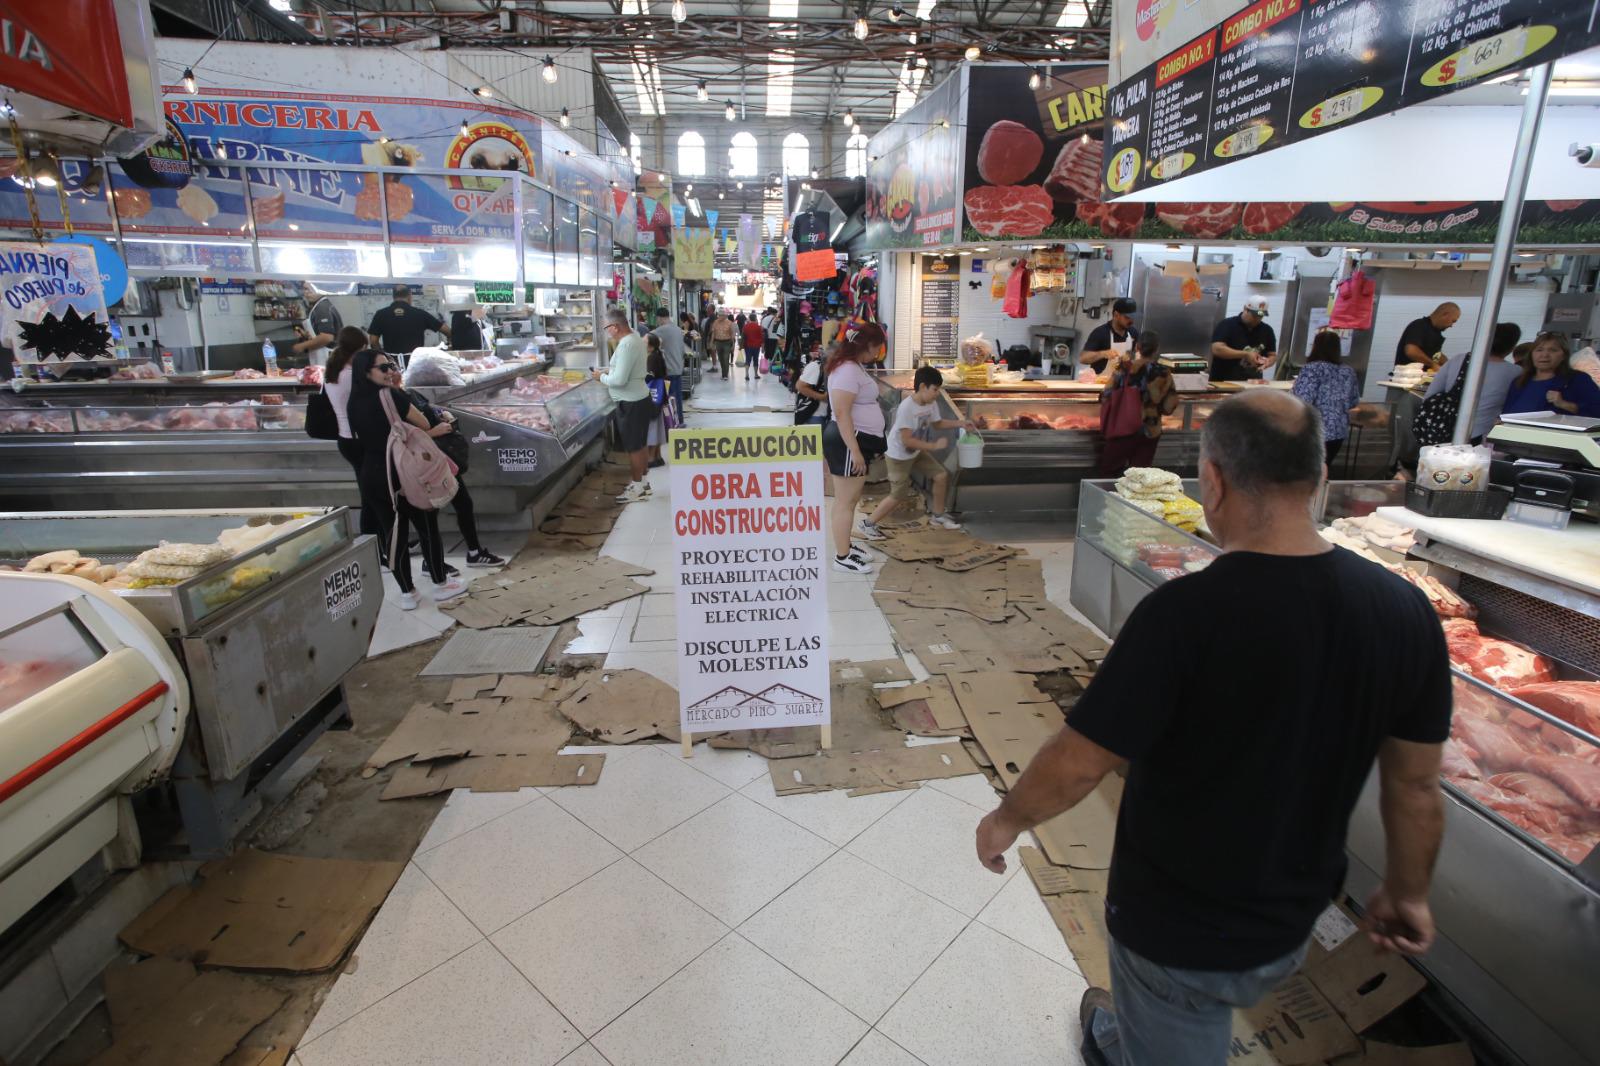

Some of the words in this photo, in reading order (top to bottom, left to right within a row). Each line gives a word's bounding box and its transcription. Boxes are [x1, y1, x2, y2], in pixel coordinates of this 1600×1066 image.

[1225, 8, 1263, 44] COMBO
[1265, 0, 1285, 22] NO.
[1422, 39, 1434, 54] 1/2
[1434, 34, 1449, 50] Kg.
[1451, 28, 1462, 43] de
[1464, 12, 1500, 38] Chilorio
[1425, 22, 1437, 37] 1/2
[1438, 17, 1452, 33] Kg.
[1454, 10, 1466, 23] de
[1159, 53, 1188, 81] COMBO
[1189, 44, 1204, 66] NO.
[1207, 39, 1212, 55] 1
[1110, 96, 1115, 116] 1
[1115, 93, 1125, 117] Kg.
[1126, 79, 1147, 109] PULPA
[163, 101, 382, 132] RNICERIA
[188, 135, 345, 208] ARNE
[1366, 217, 1405, 233] Sabor
[1405, 221, 1422, 233] de
[1423, 219, 1438, 232] la
[1440, 208, 1479, 230] Carne
[499, 449, 536, 458] MEMO
[674, 430, 817, 460] PRECAUCIÓN
[500, 457, 536, 465] ROMERO
[691, 472, 762, 500] OBRA
[769, 471, 803, 498] EN
[675, 500, 821, 536] CONSTRUCCIÓN
[681, 548, 785, 565] PROYECTO
[792, 547, 818, 561] DE
[324, 562, 360, 596] MEMO
[681, 565, 819, 585] REHABILITACIÓN
[326, 579, 361, 609] ROMERO
[690, 585, 811, 604] INSTALACIÓN
[705, 607, 799, 624] ELECTRICA
[685, 637, 780, 657] DISCULPE
[785, 635, 821, 651] LAS
[699, 655, 809, 674] MOLESTIAS
[686, 707, 741, 721] MERCADO
[749, 705, 777, 718] PINO
